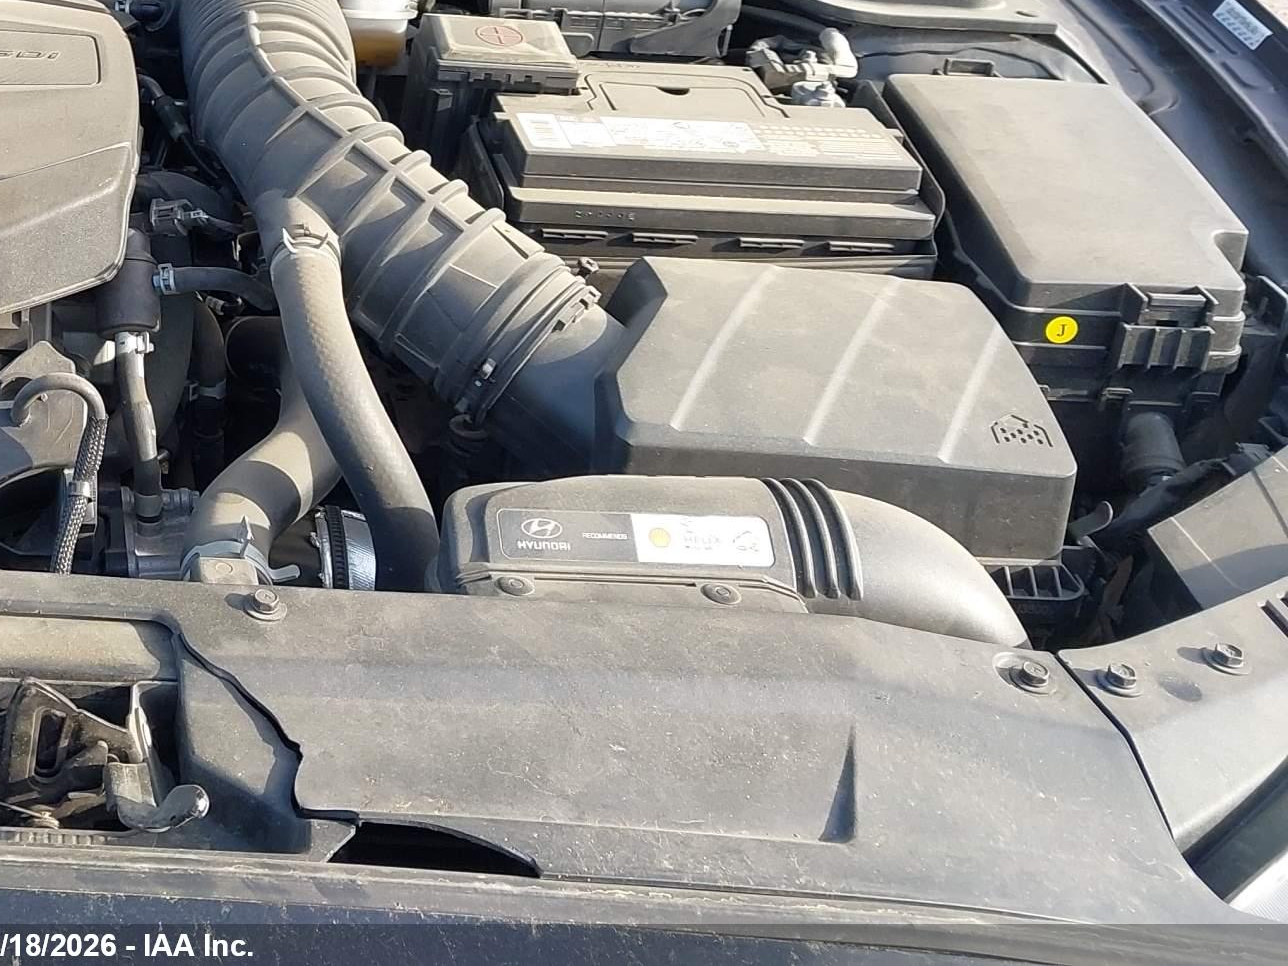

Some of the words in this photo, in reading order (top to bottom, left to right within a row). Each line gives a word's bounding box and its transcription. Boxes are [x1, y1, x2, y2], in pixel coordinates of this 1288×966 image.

[1056, 323, 1068, 338] J
[582, 532, 628, 540] RECOMMENDS
[517, 540, 572, 551] HYUNDAI
